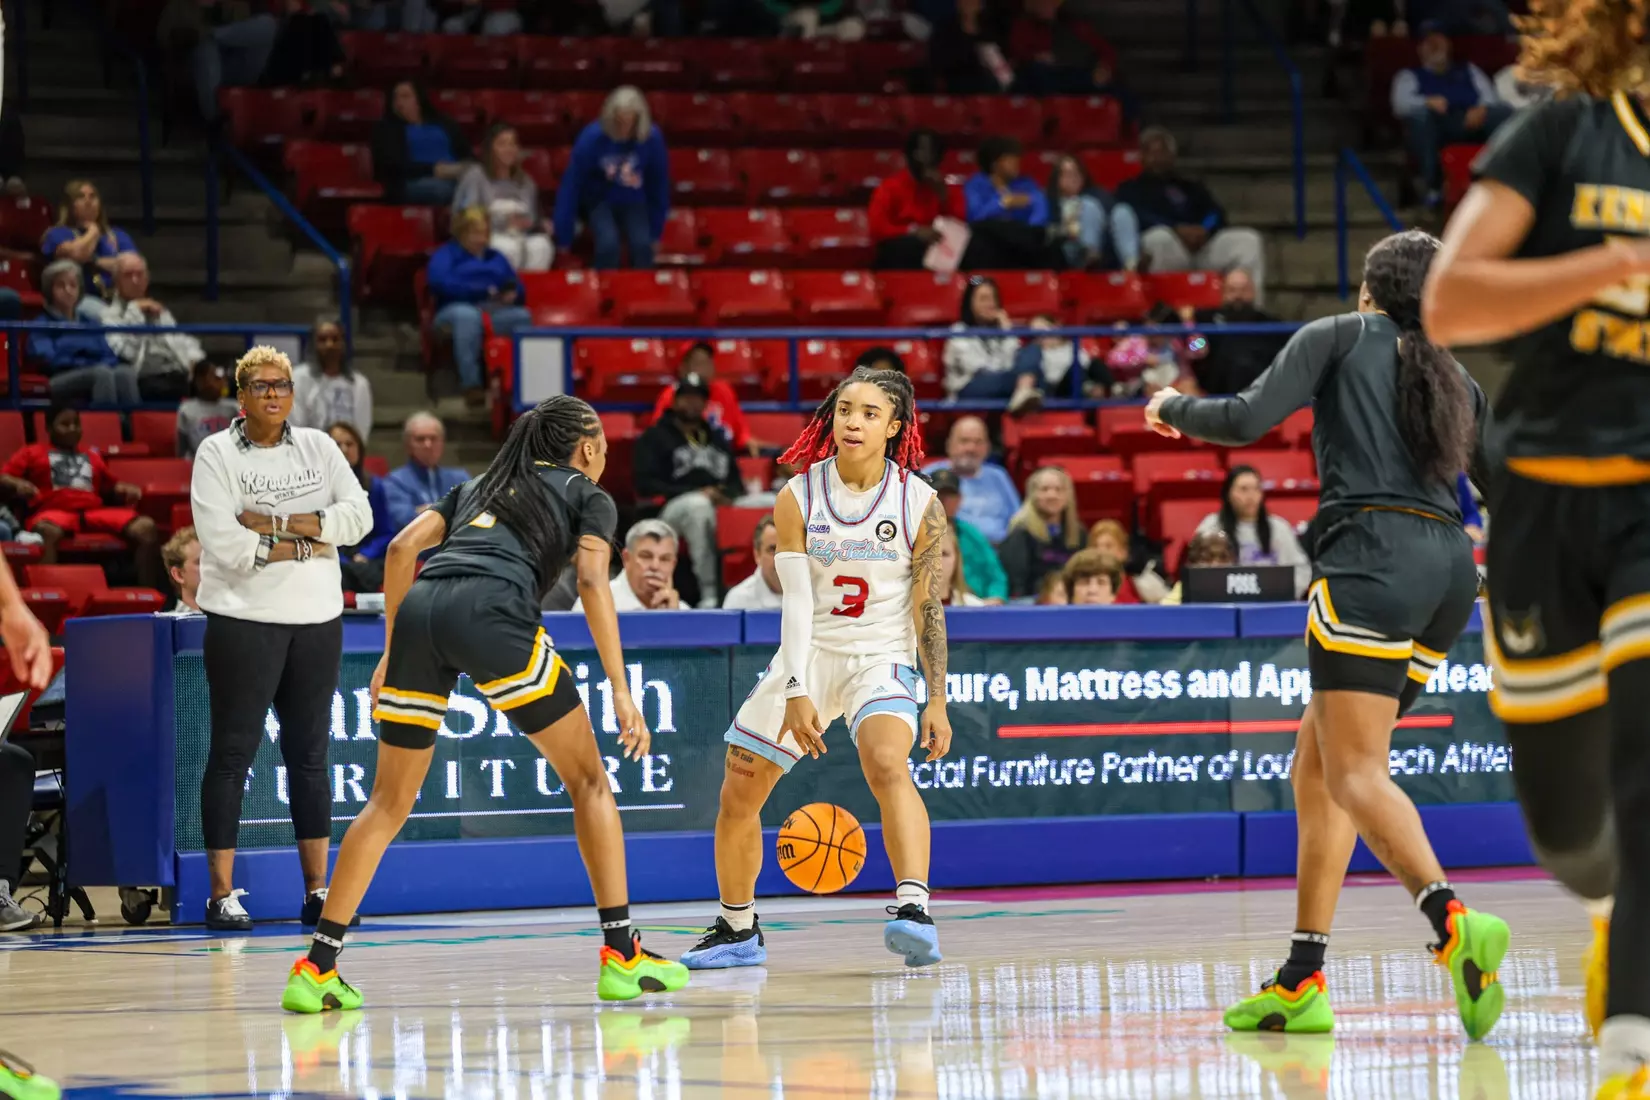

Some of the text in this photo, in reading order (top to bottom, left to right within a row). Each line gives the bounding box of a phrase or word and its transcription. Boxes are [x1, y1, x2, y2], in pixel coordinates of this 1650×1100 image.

[807, 537, 899, 567] Lady Techsters
[830, 575, 870, 618] 3
[1025, 666, 1183, 702] Mattress
[1187, 660, 1251, 699] and
[971, 754, 1096, 788] Furniture
[1101, 750, 1204, 784] Partner
[1207, 749, 1239, 782] of
[1388, 743, 1436, 776] ech
